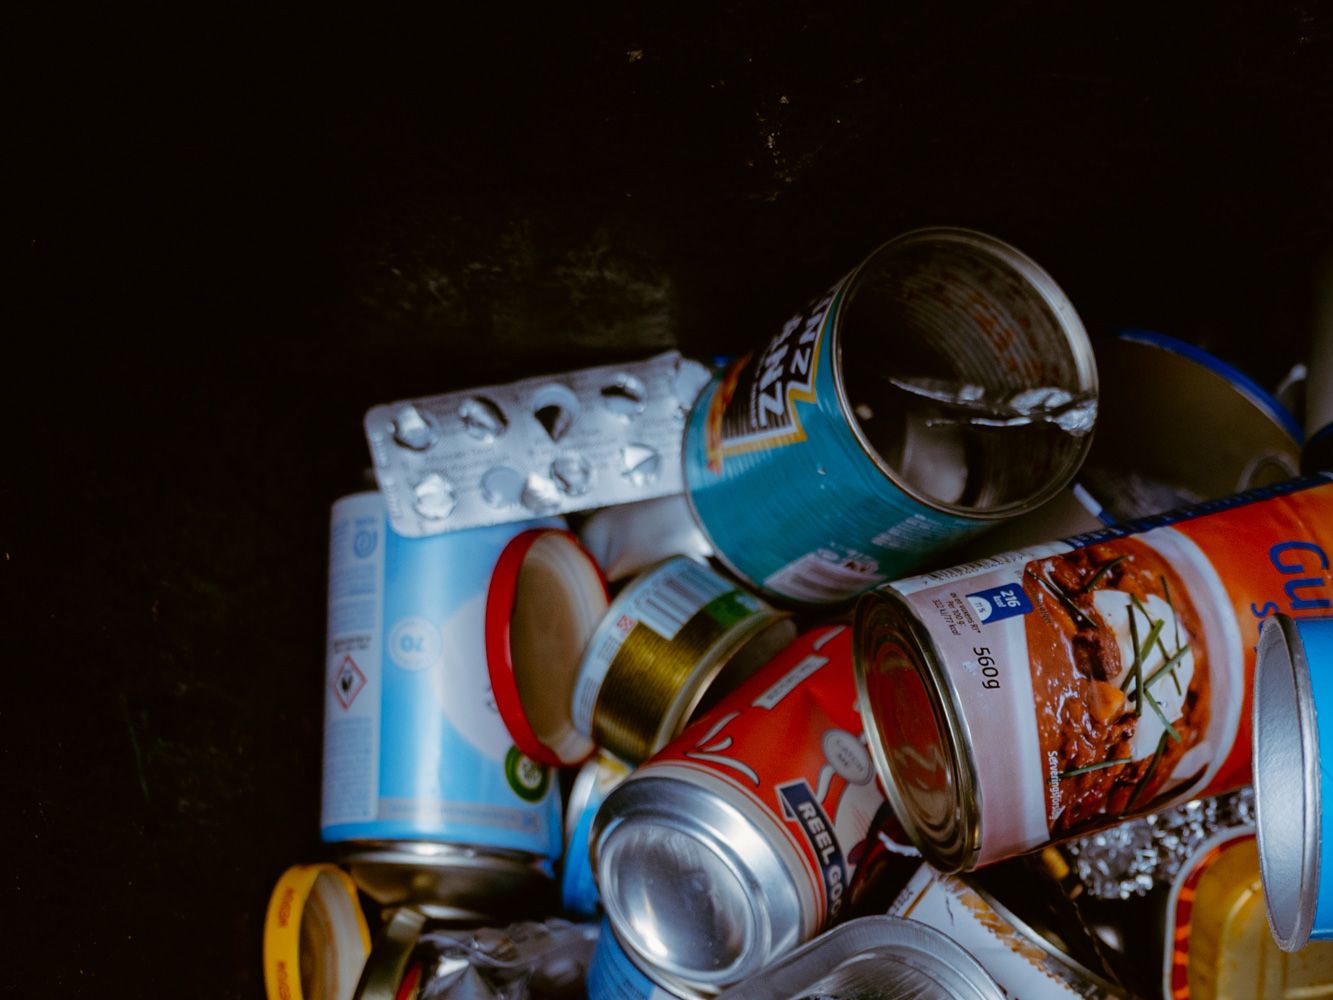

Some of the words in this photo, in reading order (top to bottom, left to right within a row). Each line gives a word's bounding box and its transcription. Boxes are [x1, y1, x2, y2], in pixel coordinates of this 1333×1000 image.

[999, 587, 1021, 611] 216
[973, 647, 999, 689] 560g
[794, 797, 842, 866] REEL
[826, 862, 844, 925] GOO
